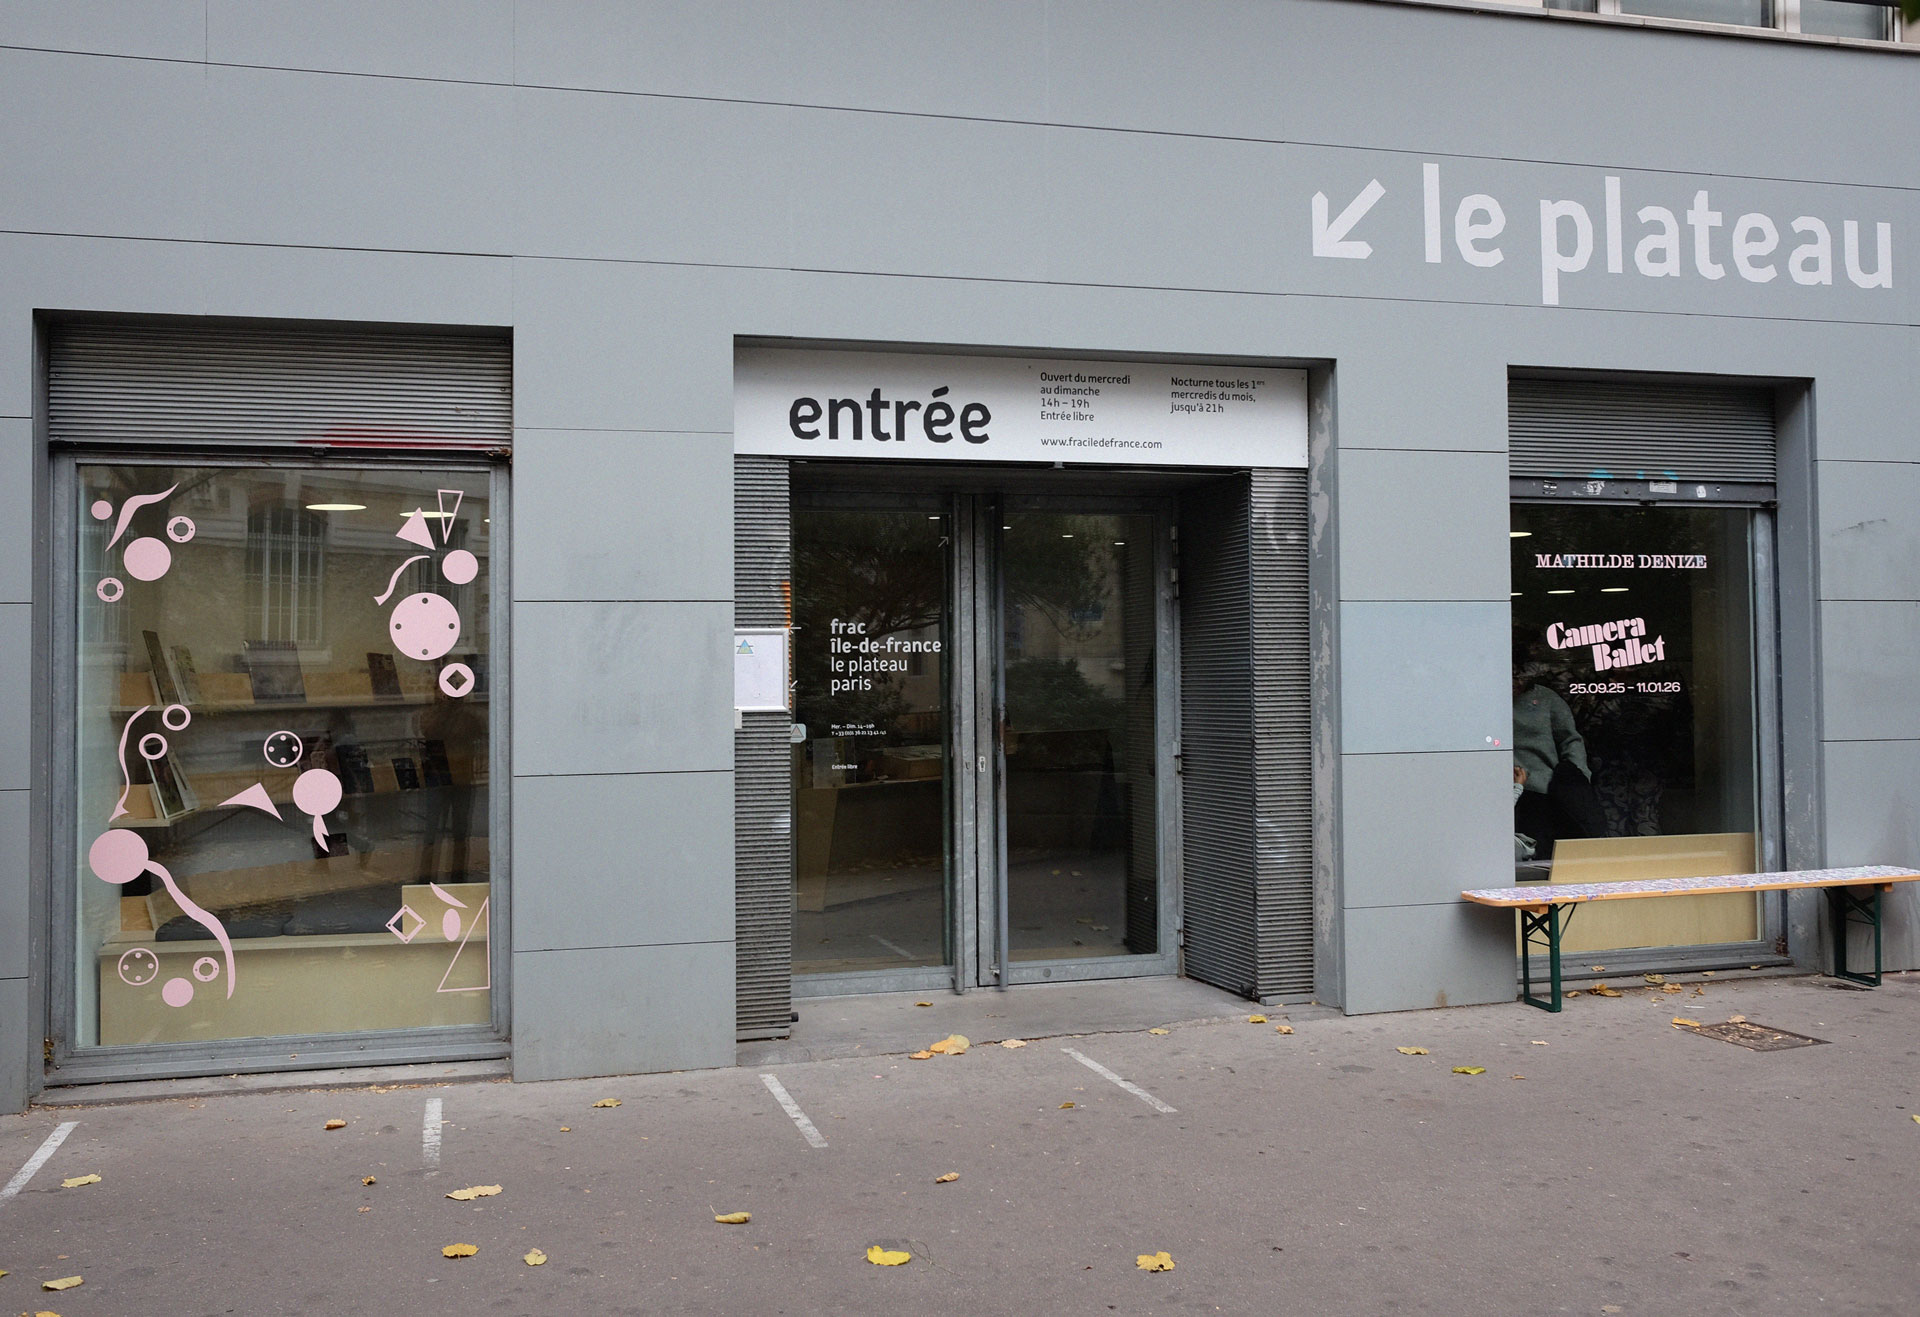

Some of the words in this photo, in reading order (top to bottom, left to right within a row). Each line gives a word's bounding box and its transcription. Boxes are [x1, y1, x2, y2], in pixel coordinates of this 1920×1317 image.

[1423, 162, 1506, 268] le
[1540, 175, 1893, 305] plateau
[1040, 372, 1072, 382] Ouvert
[1074, 373, 1086, 383] du
[1088, 375, 1131, 384] mercredi
[1171, 377, 1214, 387] Nocturne
[1215, 379, 1236, 388] tous
[1237, 380, 1249, 389] les
[1040, 386, 1051, 394] au
[1054, 386, 1100, 396] dimanche
[1171, 391, 1217, 400] mercredis
[1218, 391, 1230, 401] du
[1232, 392, 1256, 403] mois,
[789, 385, 992, 444] entrée
[1170, 402, 1204, 414] jusqu'à
[1040, 411, 1071, 420] Entrée
[1073, 412, 1094, 421] libre
[1041, 437, 1162, 449] www.fraciledefrance.com
[1535, 554, 1634, 569] MATHILDE
[1638, 554, 1707, 569] DENIZE
[830, 618, 866, 635] frac
[1546, 617, 1647, 650] Camera
[830, 636, 942, 654] île-de-france
[1591, 634, 1666, 672] Ballet
[831, 656, 845, 672] le
[848, 656, 908, 677] plateau
[831, 676, 872, 696] paris
[1569, 682, 1626, 694] 25.09.25
[1636, 682, 1681, 693] 11.01.26
